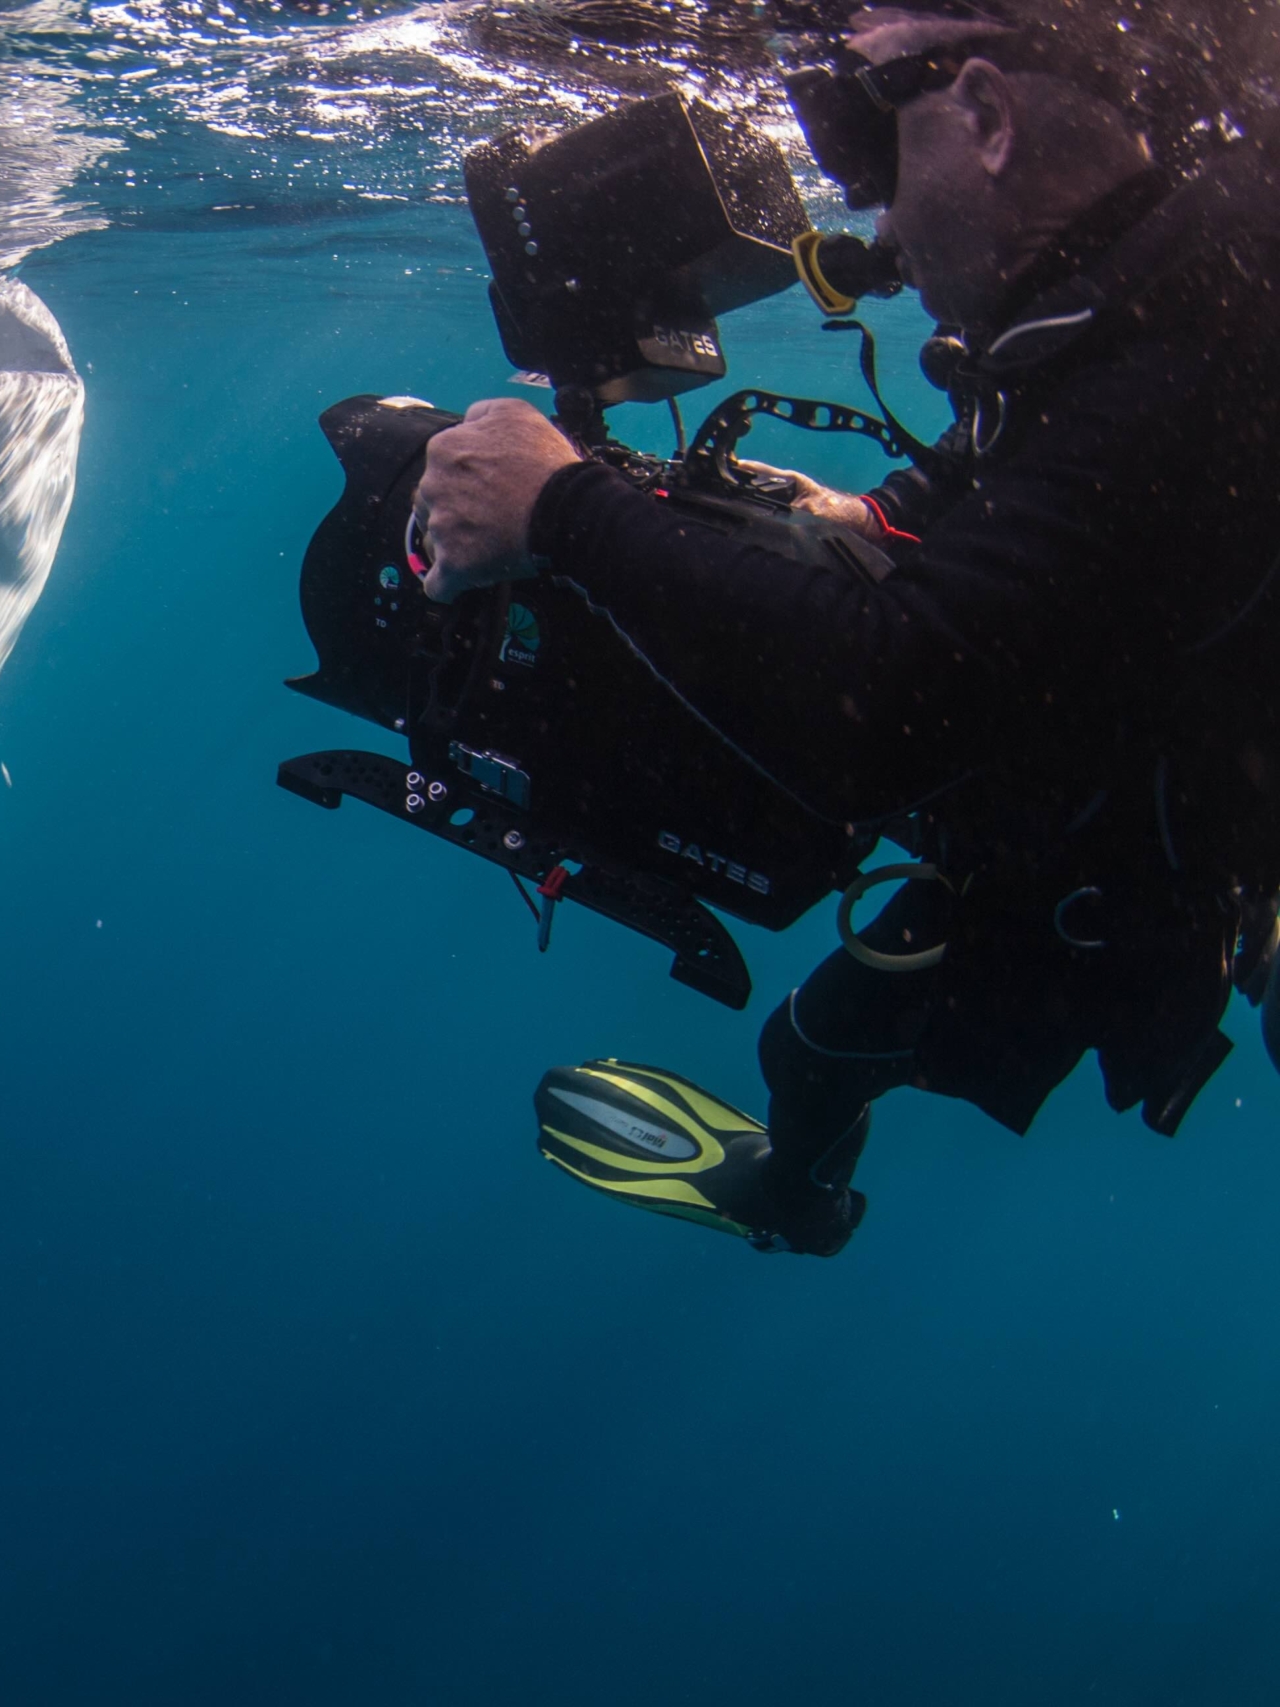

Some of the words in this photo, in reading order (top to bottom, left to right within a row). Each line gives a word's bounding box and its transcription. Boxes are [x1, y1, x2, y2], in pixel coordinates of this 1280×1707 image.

[653, 325, 718, 356] GATES
[508, 648, 535, 663] esprit
[658, 830, 770, 895] GATES
